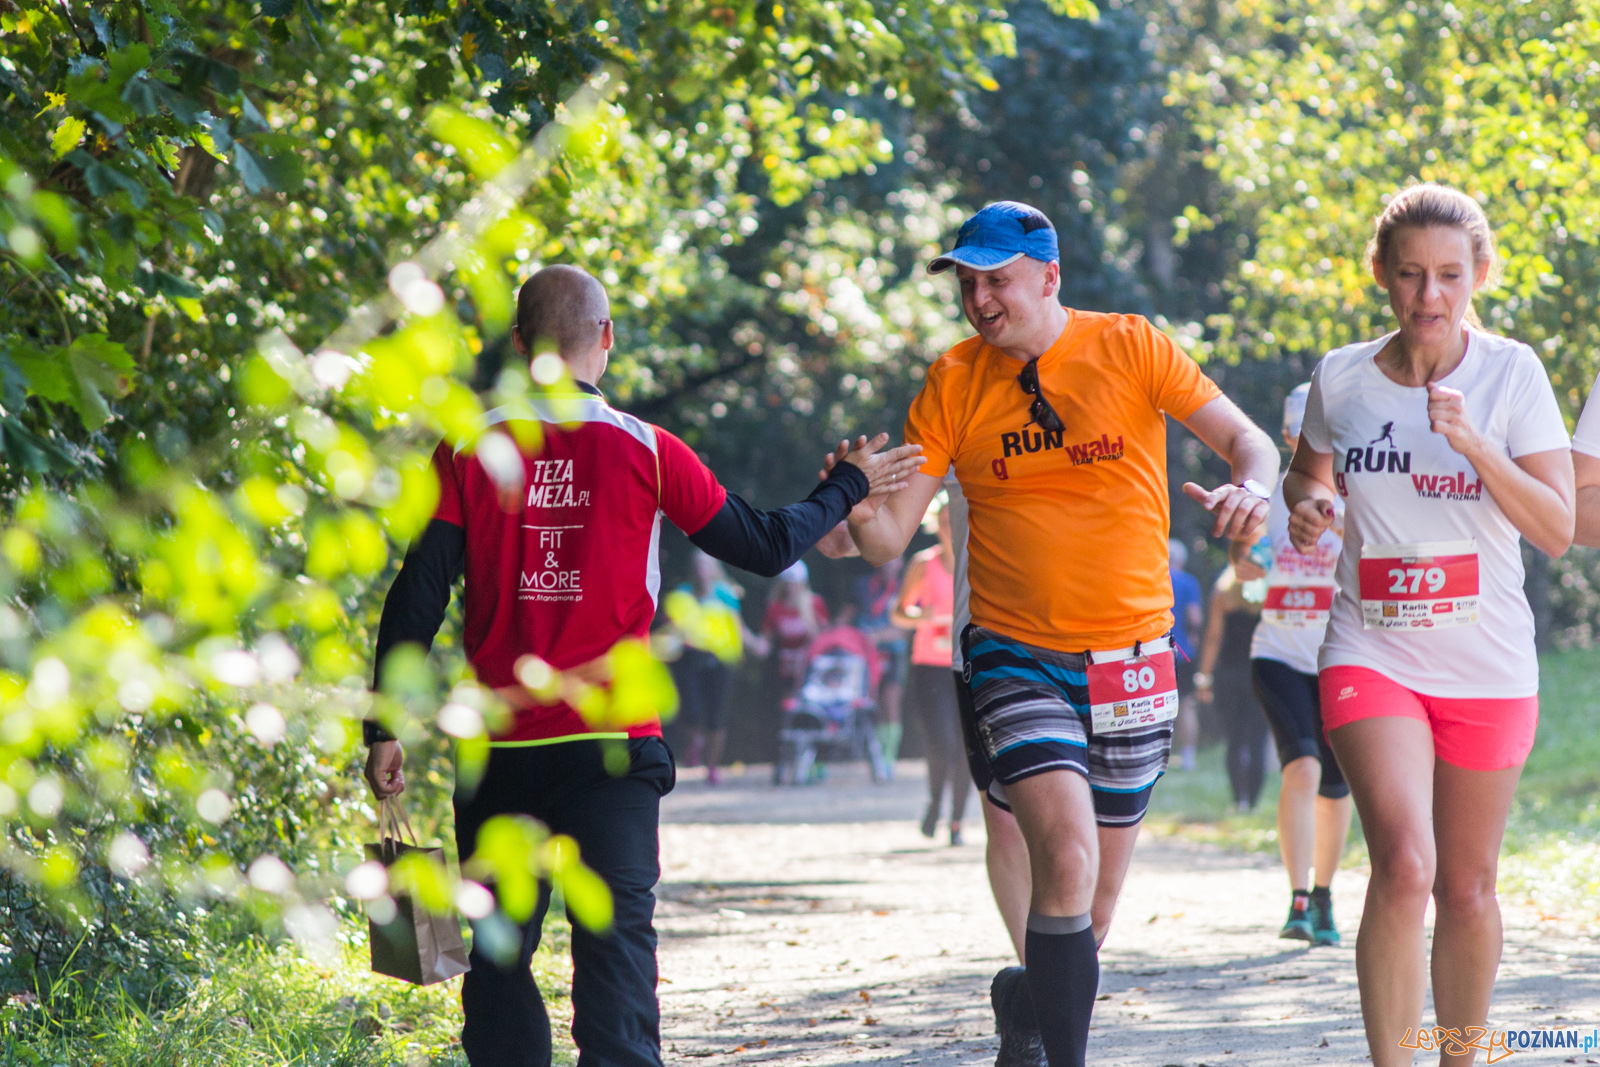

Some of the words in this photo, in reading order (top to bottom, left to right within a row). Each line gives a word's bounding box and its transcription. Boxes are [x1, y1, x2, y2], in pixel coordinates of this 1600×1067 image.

[1001, 429, 1064, 458] RUN
[1065, 434, 1124, 462] wald
[1072, 456, 1094, 467] TEAM
[1344, 446, 1411, 474] RUN
[1411, 471, 1482, 494] wald
[533, 459, 574, 483] TEZA
[1417, 490, 1442, 499] TEAM
[539, 531, 563, 549] FIT
[544, 551, 559, 568] &
[519, 570, 580, 589] MORE
[1388, 567, 1446, 594] 279
[518, 594, 583, 602] www.fitandmore.pl
[1122, 666, 1155, 692] 80
[1131, 700, 1152, 709] Karlik
